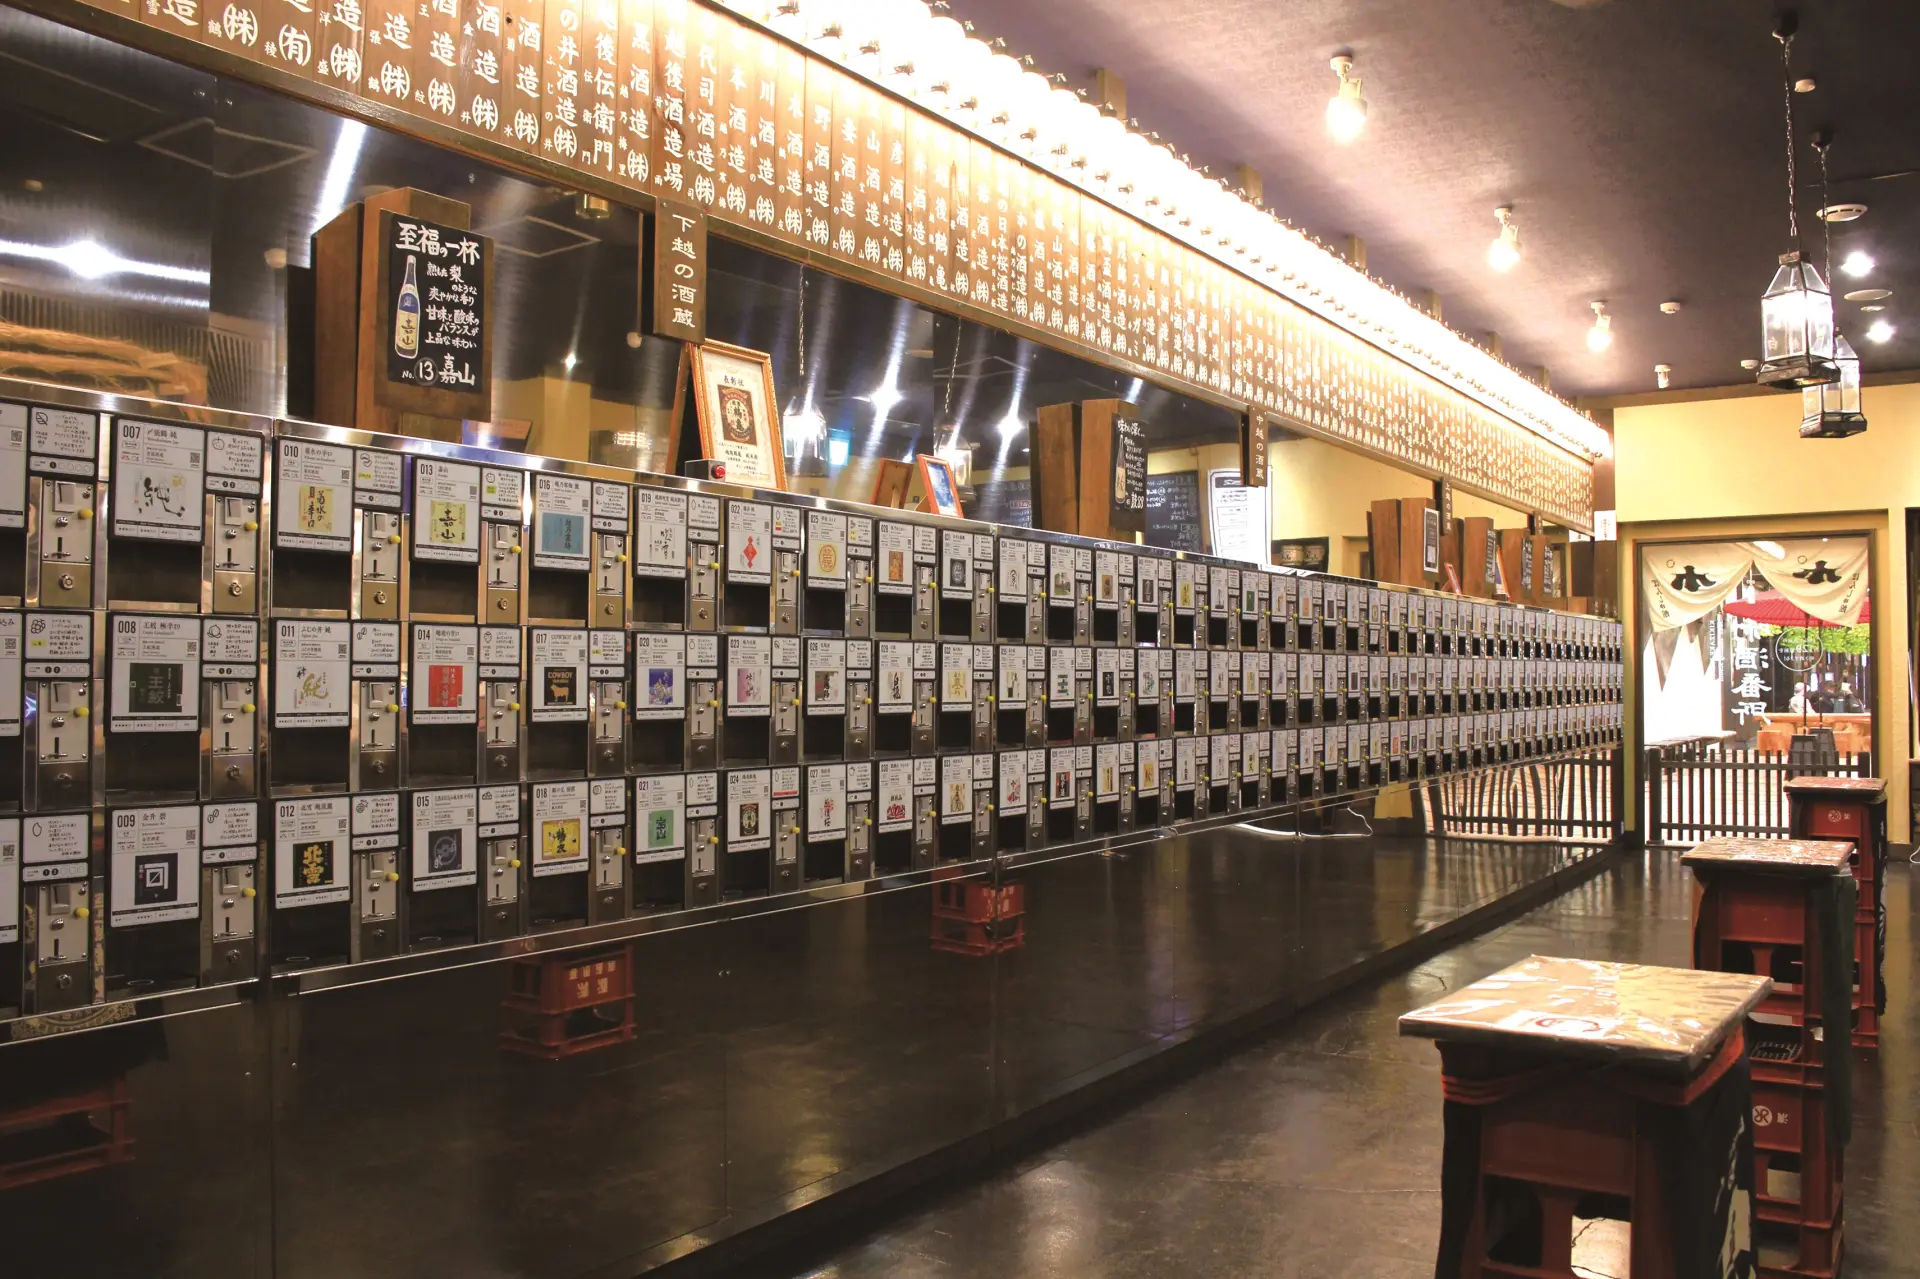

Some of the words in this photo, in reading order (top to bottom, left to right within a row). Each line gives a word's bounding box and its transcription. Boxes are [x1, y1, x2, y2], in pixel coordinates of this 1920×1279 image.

[395, 221, 481, 266] 至福の一杯
[672, 214, 697, 328] 下越の酒蔵
[123, 425, 141, 439] 007
[284, 445, 299, 458] 010
[420, 463, 433, 476] 013
[118, 620, 136, 634] 008
[281, 625, 295, 637] 011
[417, 629, 431, 640] 014
[535, 633, 547, 644] 017
[547, 671, 573, 679] COWBOY
[639, 781, 649, 791] 021
[536, 787, 548, 799] 018
[416, 795, 430, 808] 015
[280, 805, 295, 818] 012
[117, 815, 135, 828] 009
